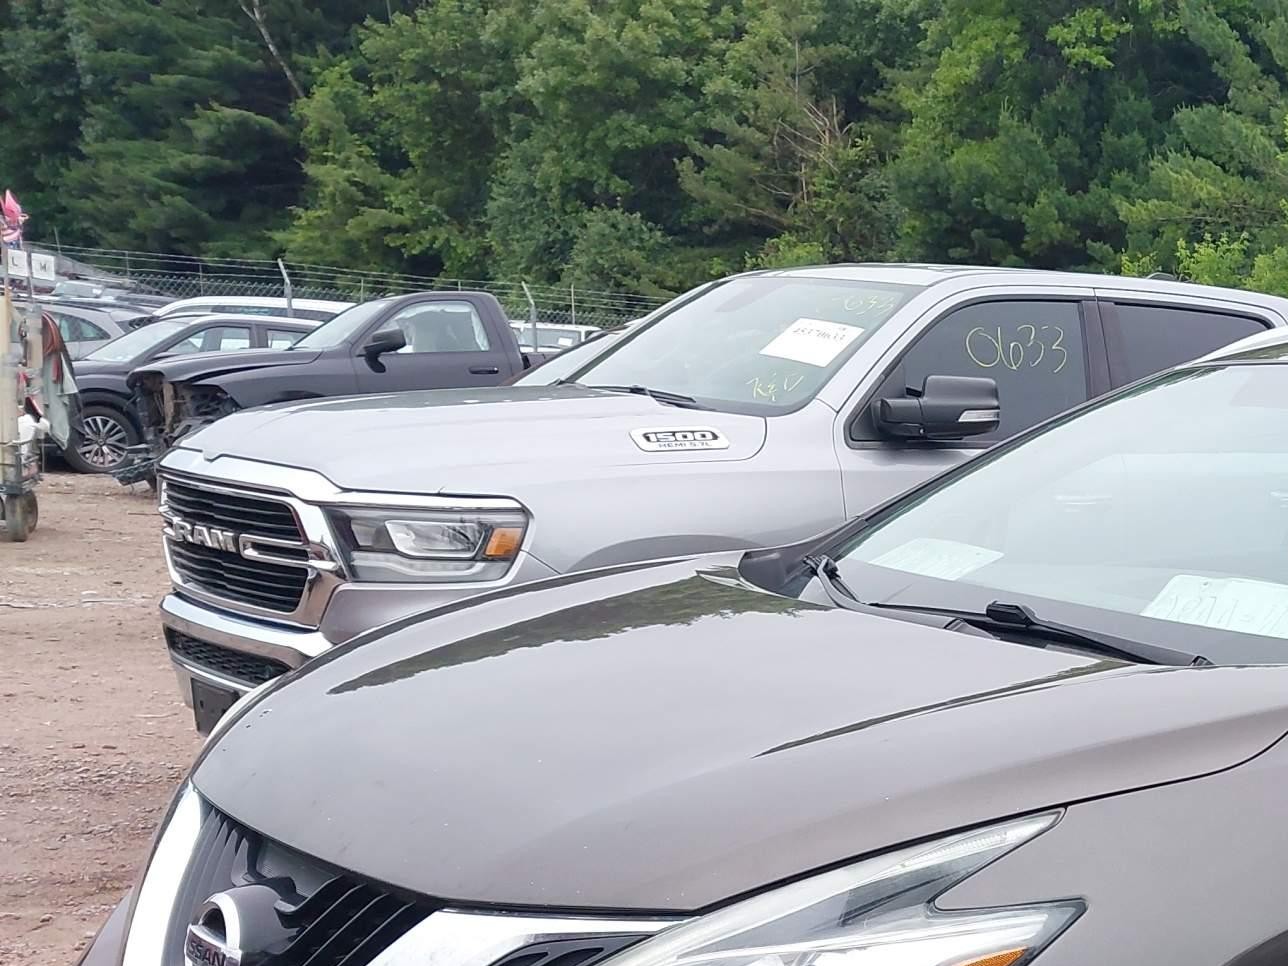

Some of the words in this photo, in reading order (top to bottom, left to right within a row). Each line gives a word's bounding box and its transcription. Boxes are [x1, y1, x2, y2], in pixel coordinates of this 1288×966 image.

[966, 324, 1067, 373] 0633
[644, 431, 714, 442] 1500
[173, 517, 238, 553] RAM
